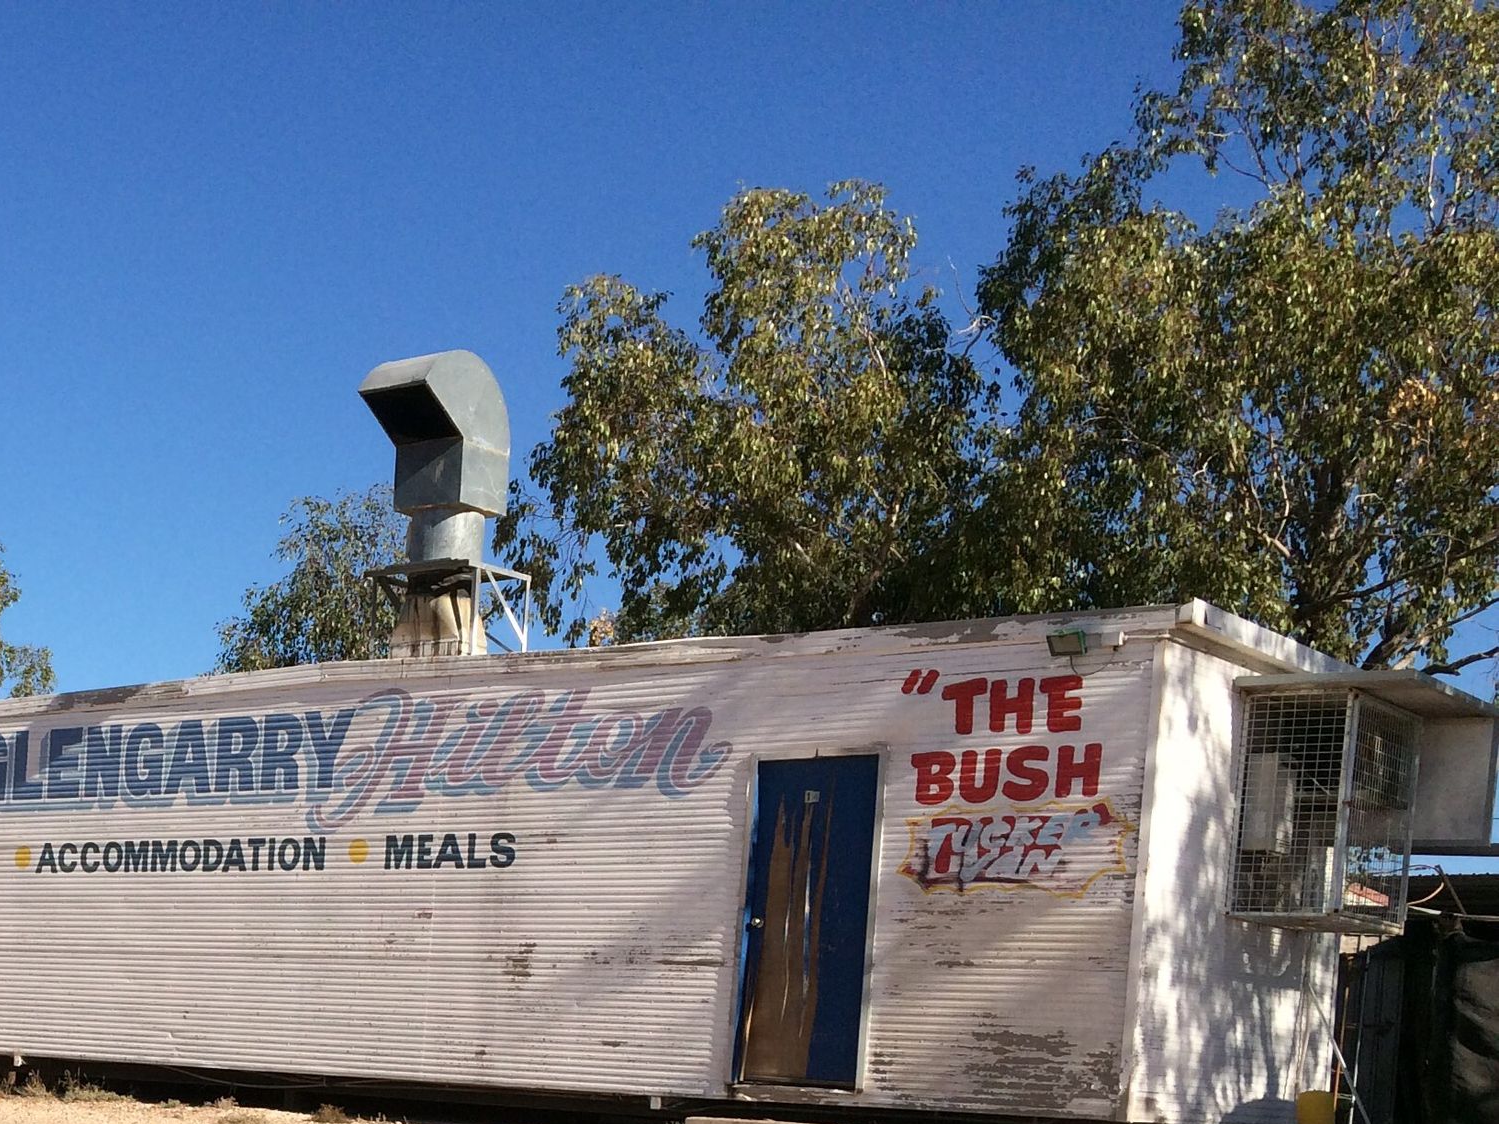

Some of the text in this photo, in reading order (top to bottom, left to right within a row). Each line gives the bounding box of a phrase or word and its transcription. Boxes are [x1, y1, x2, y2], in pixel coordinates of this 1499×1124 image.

[306, 687, 733, 834] Hilton
[910, 742, 1103, 806] BUSH
[34, 832, 517, 874] ACCOMMODATION MEALS
